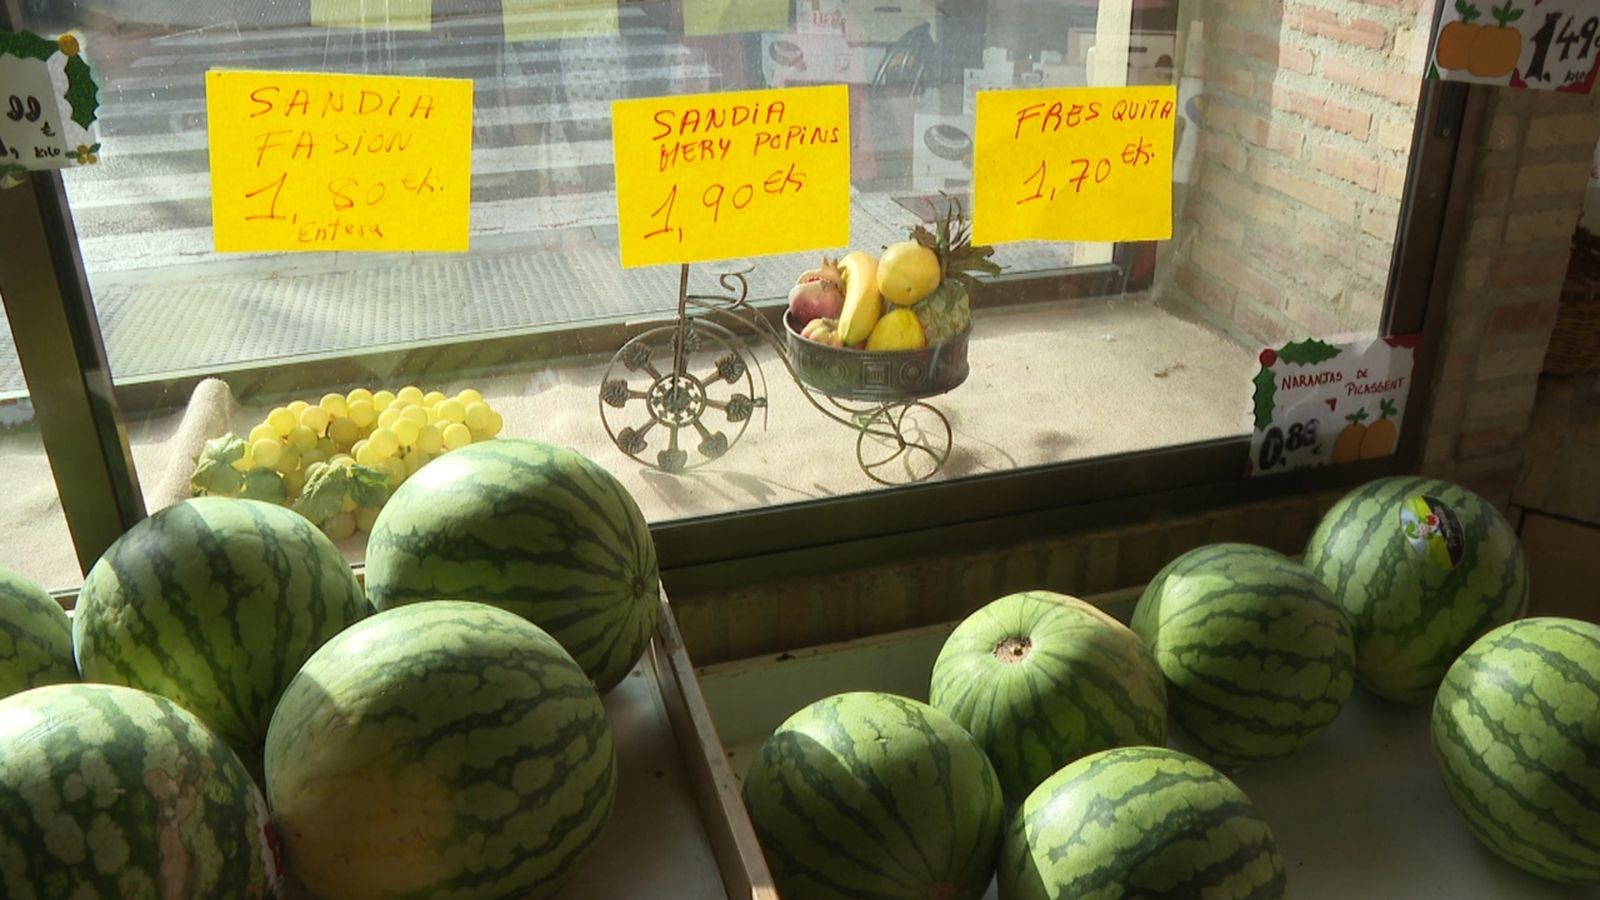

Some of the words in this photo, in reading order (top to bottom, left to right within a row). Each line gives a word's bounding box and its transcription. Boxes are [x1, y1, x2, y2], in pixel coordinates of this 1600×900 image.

[1016, 159, 1111, 205] 1,70
[1281, 371, 1343, 390] NARANJAS
[1344, 377, 1405, 396] PICASSENT
